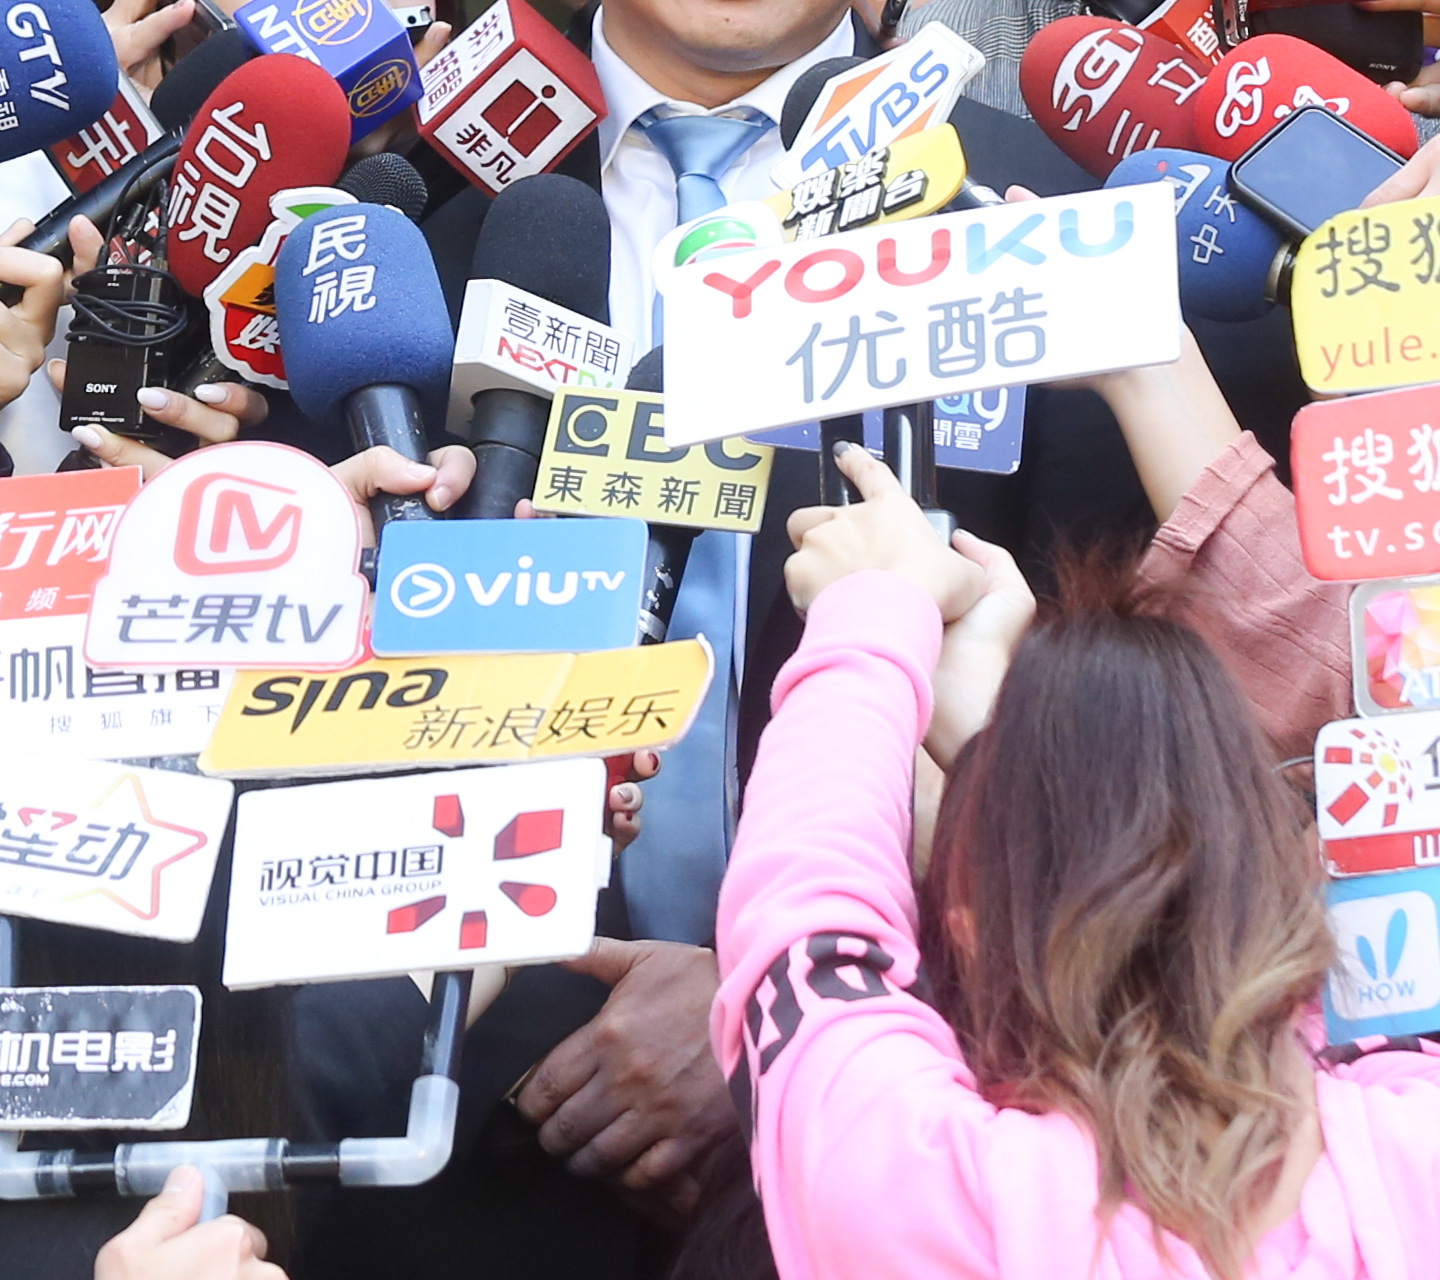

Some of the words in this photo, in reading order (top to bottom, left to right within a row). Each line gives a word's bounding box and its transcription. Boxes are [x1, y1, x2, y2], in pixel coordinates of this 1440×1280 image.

[6, 2, 70, 111] GTV
[801, 50, 949, 172] TVBS
[168, 102, 271, 263] 台視
[455, 122, 517, 185] 非凡
[303, 215, 376, 323] 民視
[703, 201, 1134, 318] YOUKU
[502, 297, 621, 375] 壹新聞
[786, 288, 1048, 403] 优酷
[86, 383, 117, 394] SONY
[545, 466, 757, 521] 東森新聞
[403, 689, 680, 750] 新浪娱乐
[259, 891, 320, 907] VISUAL
[325, 887, 376, 901] CHINA
[381, 880, 442, 896] GROUP
[260, 845, 444, 891] 视觉中国
